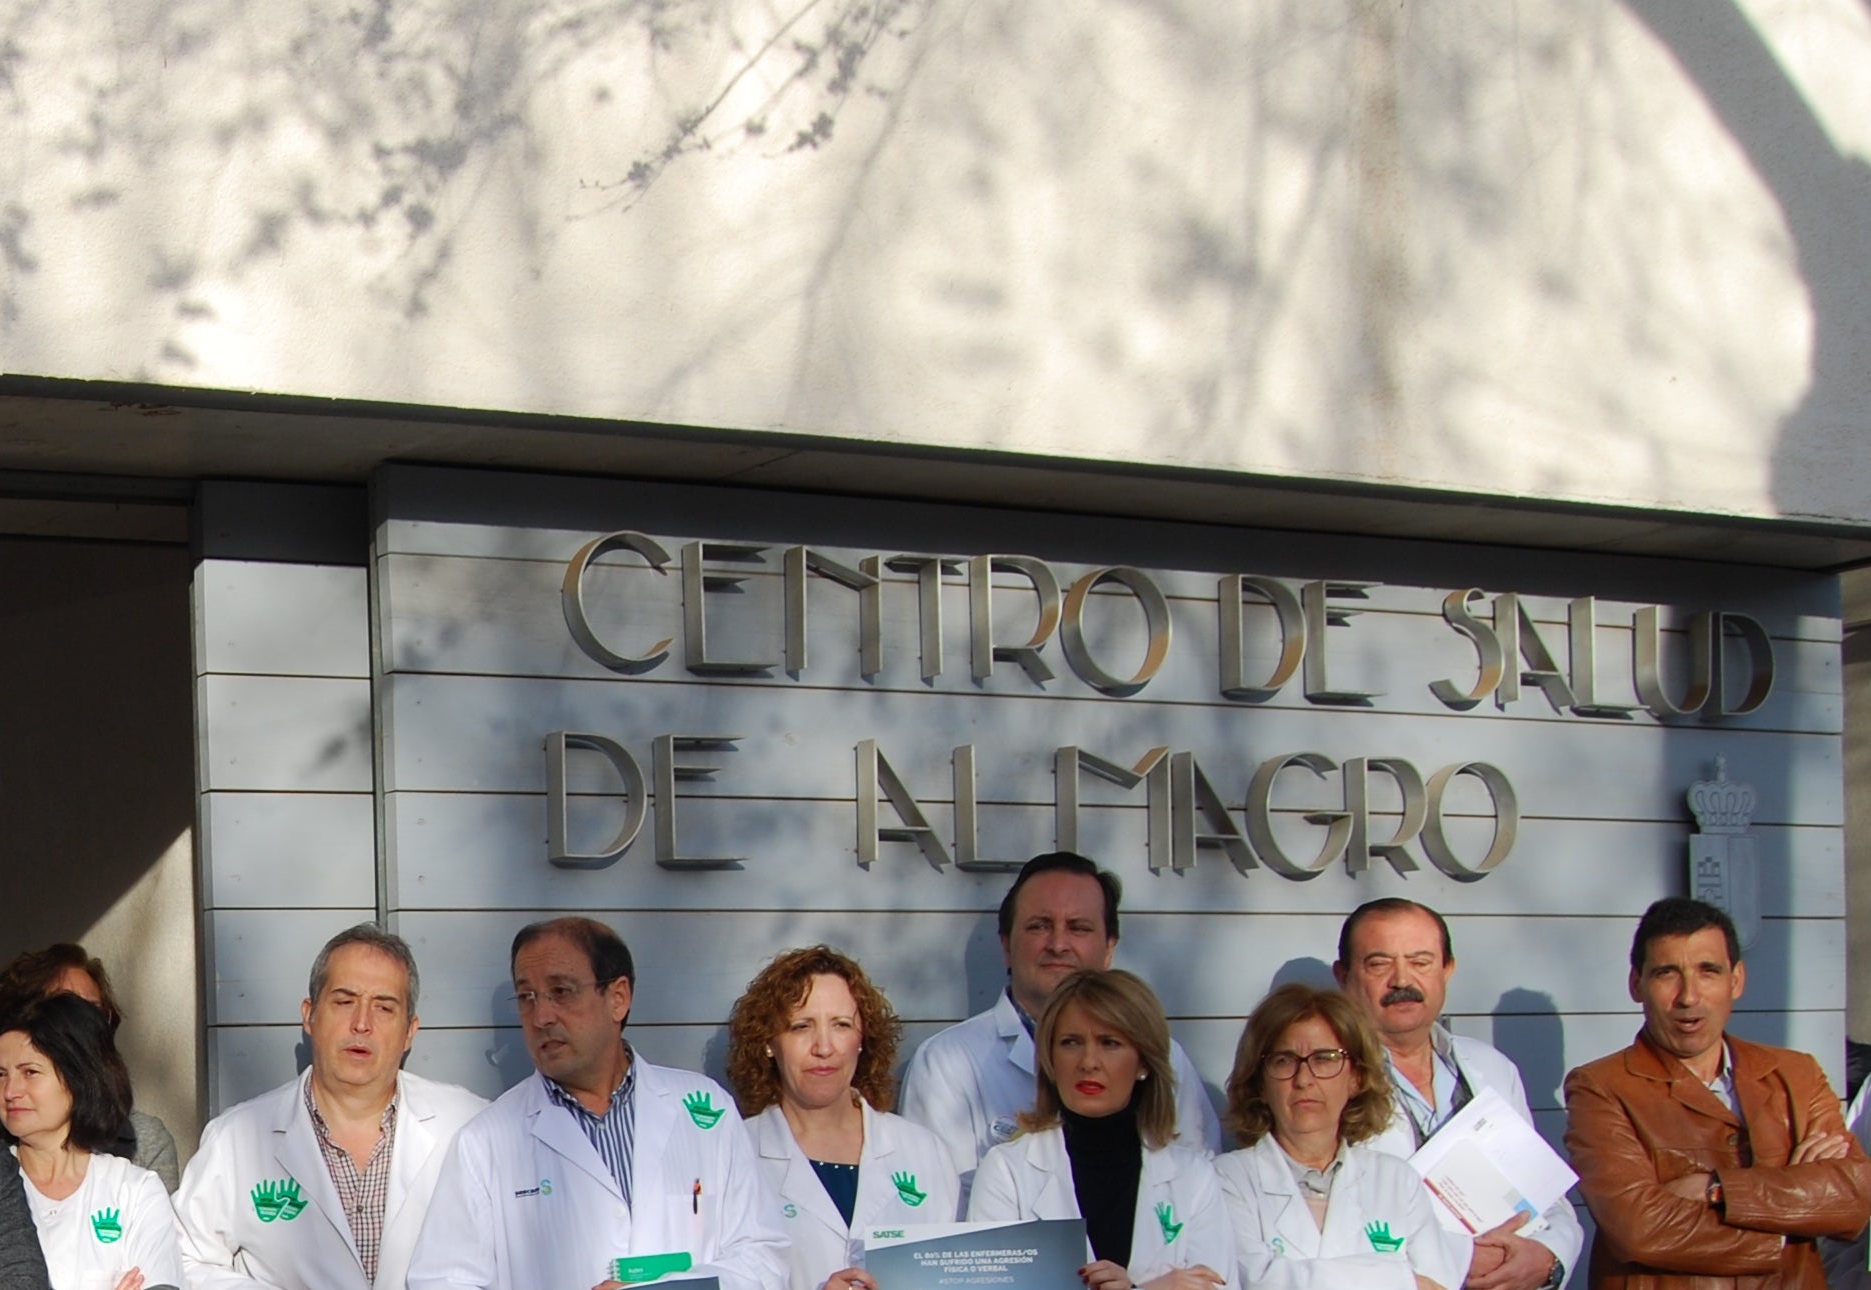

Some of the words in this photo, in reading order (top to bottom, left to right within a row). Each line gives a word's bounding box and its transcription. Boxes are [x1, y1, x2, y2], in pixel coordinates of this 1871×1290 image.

[562, 529, 1172, 696] CENTRO
[1218, 571, 1385, 706] DE
[1428, 586, 1775, 720] SALUD
[545, 729, 748, 869] DE
[855, 745, 1520, 881] ALMAGRO
[873, 1230, 905, 1238] SATSE
